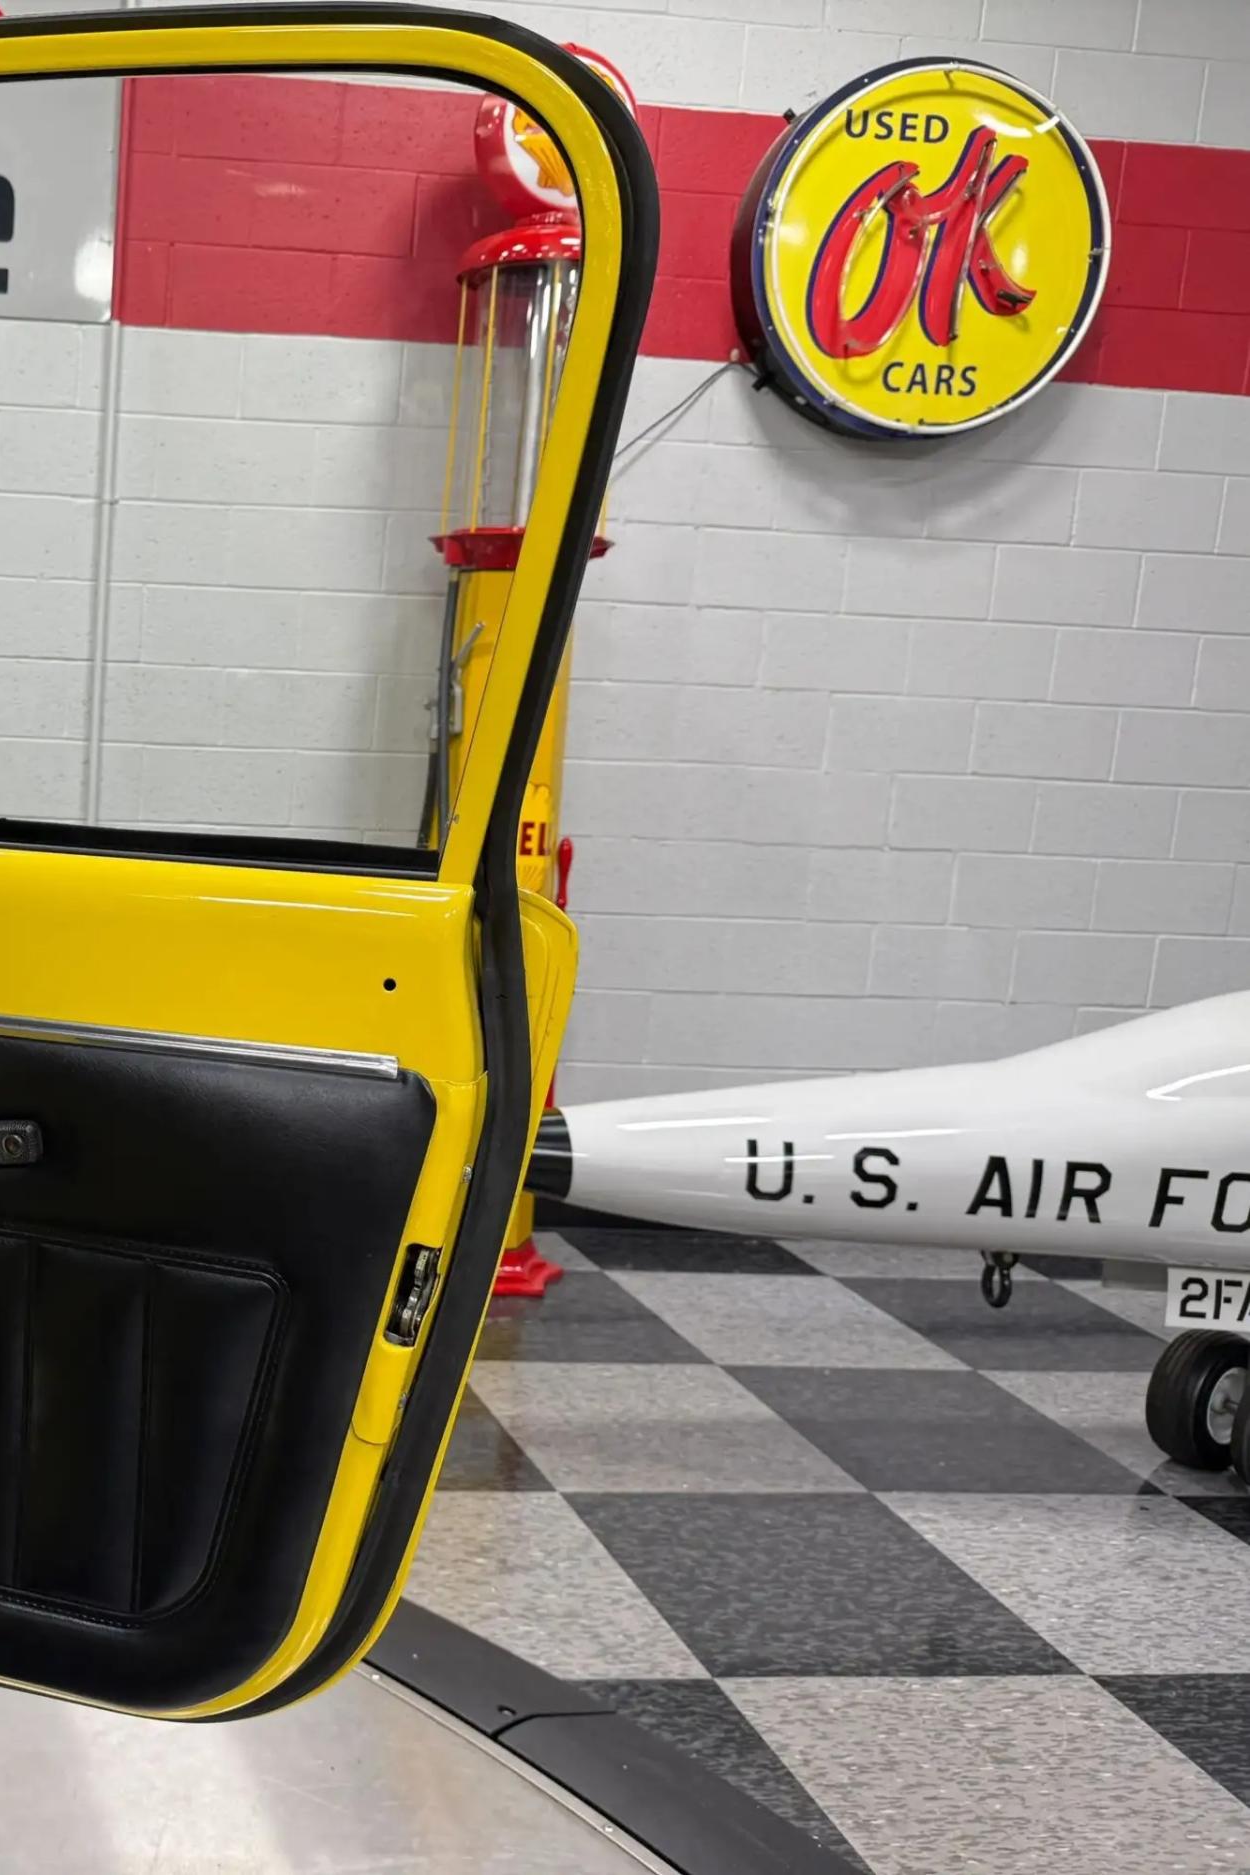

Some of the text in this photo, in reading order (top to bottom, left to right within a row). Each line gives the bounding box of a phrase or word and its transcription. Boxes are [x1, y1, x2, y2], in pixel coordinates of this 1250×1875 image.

[845, 109, 949, 144] USED
[806, 125, 1037, 360] OK
[882, 362, 977, 397] CARS
[965, 1155, 1113, 1224] AIR
[1148, 1167, 1250, 1233] FO
